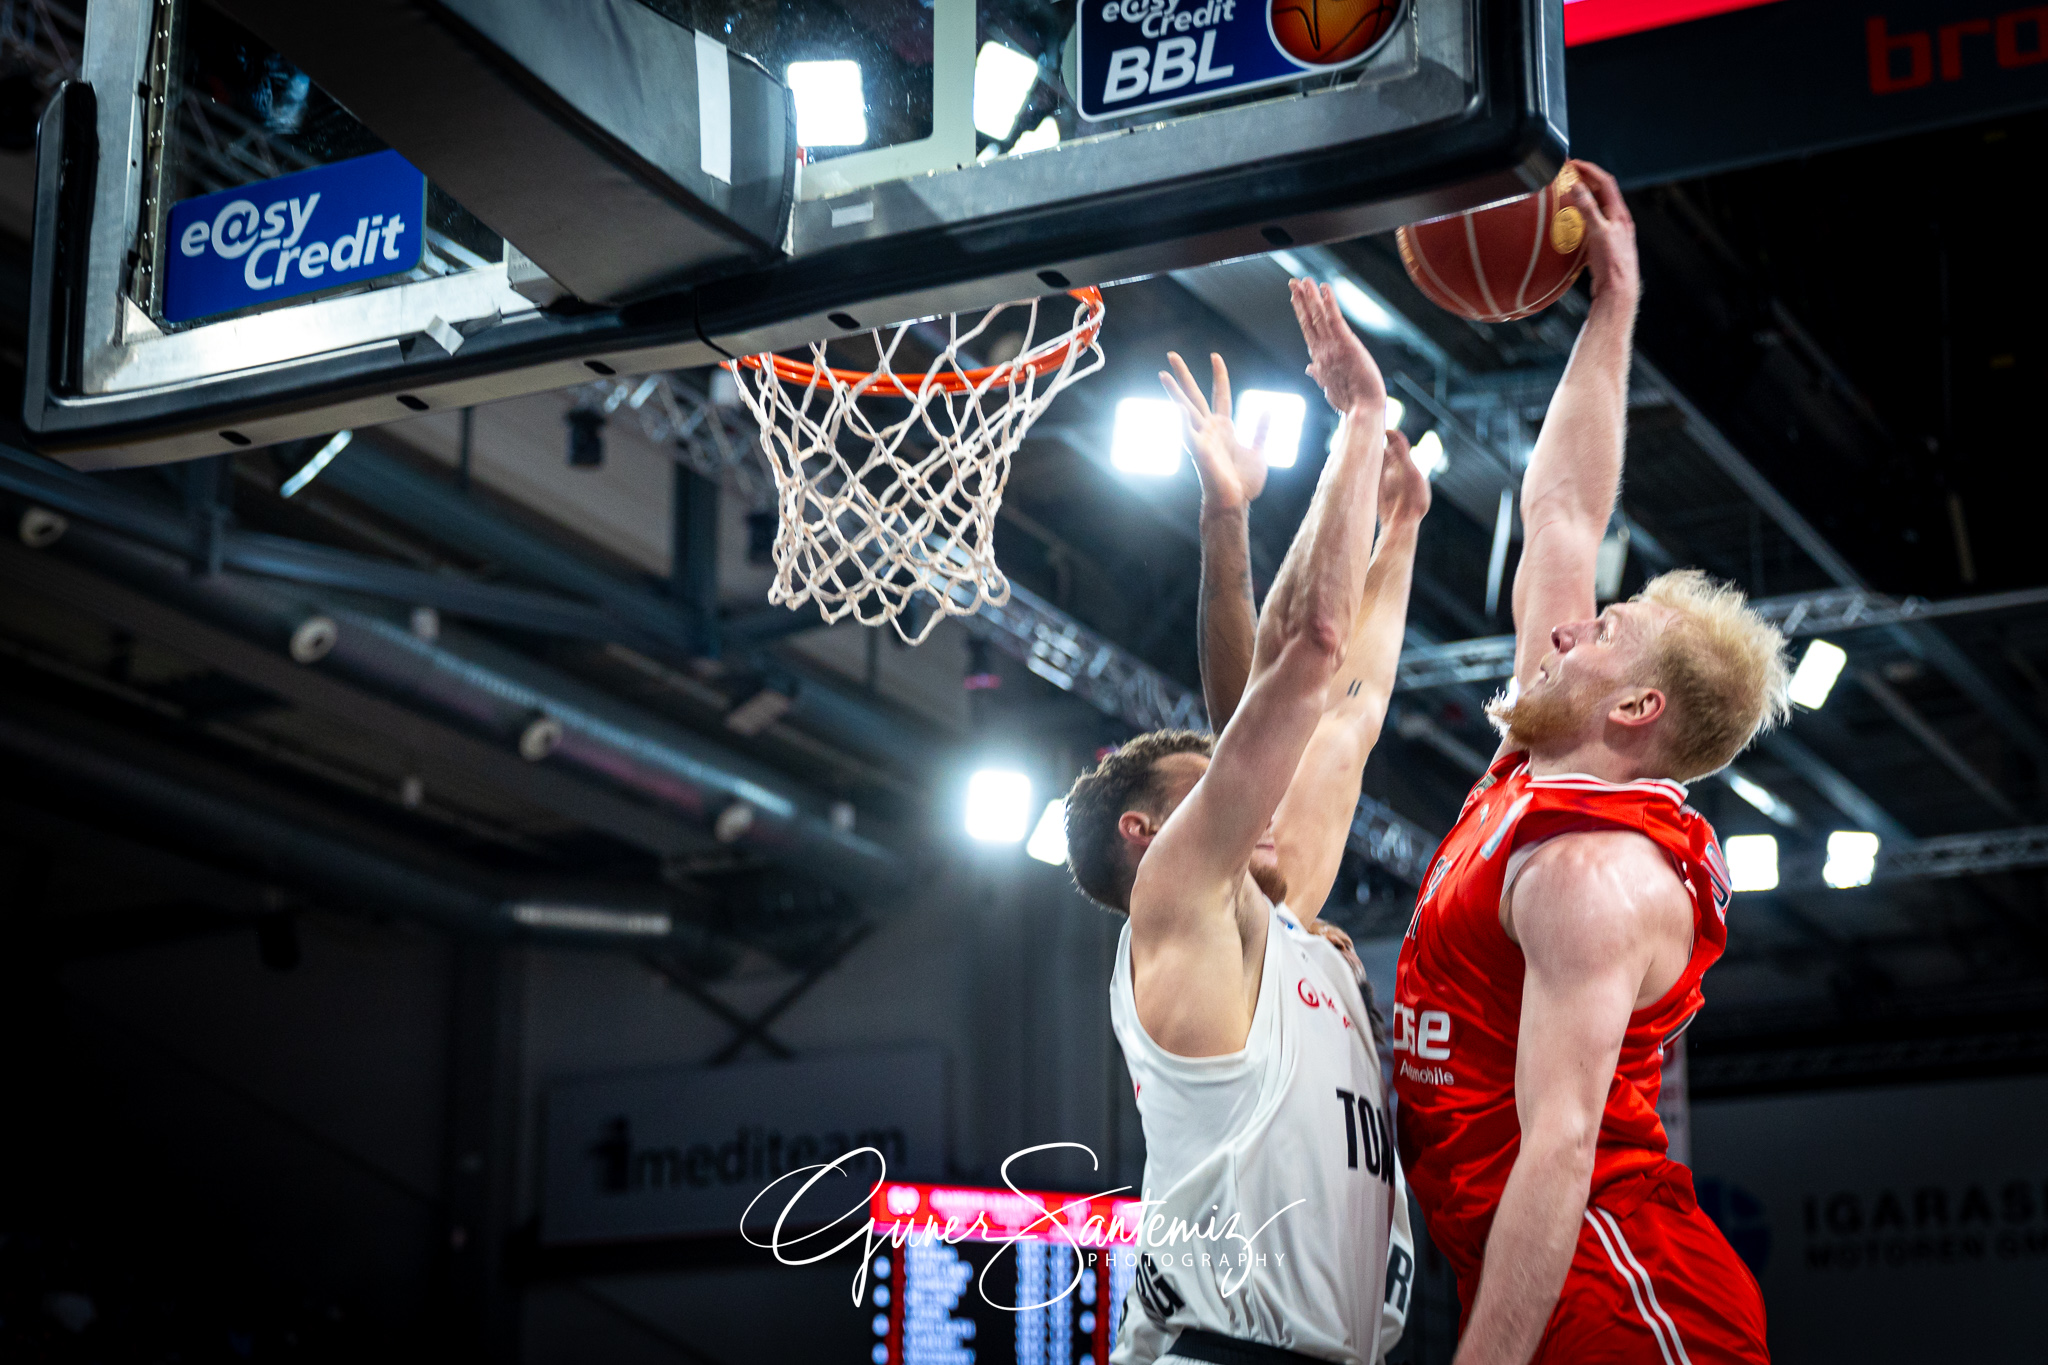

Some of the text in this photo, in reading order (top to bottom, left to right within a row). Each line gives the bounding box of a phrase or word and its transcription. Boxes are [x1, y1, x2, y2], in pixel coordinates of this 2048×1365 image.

[1141, 0, 1236, 39] Credit
[1103, 29, 1234, 105] BBL
[244, 214, 405, 290] Credit
[1803, 1180, 2048, 1237] IGARAS
